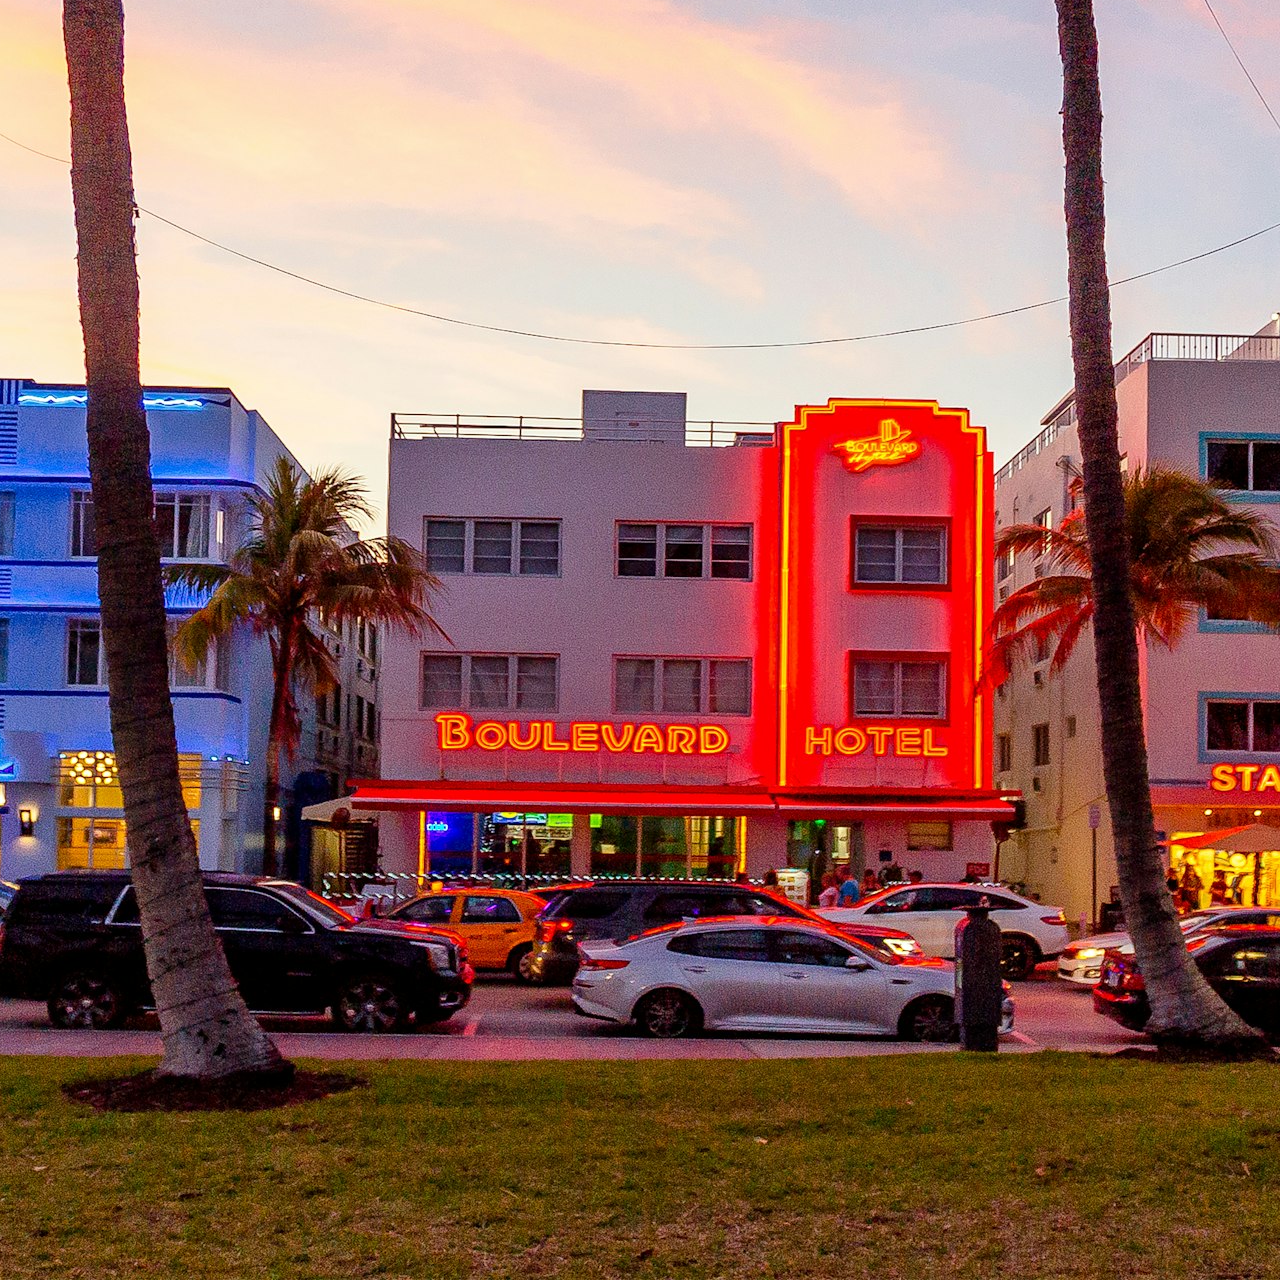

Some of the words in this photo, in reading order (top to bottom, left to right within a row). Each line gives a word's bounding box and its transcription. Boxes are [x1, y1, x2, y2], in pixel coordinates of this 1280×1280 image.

[845, 440, 918, 454] BOULEVARD
[436, 714, 730, 755] BOULEVARD
[805, 726, 949, 757] HOTEL
